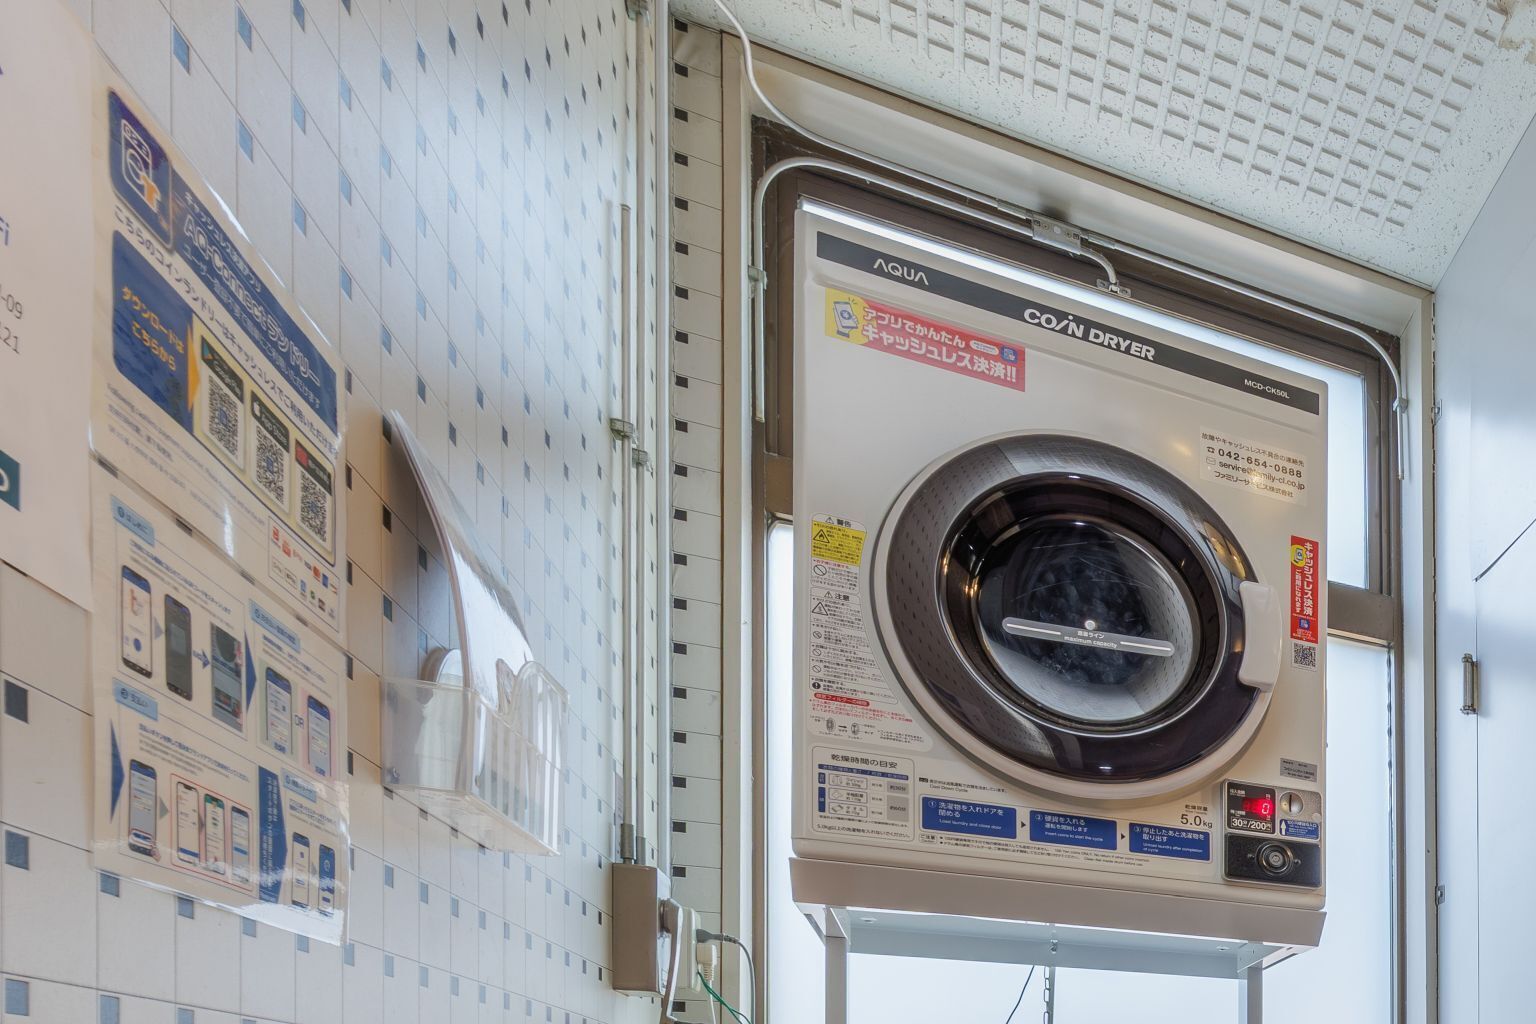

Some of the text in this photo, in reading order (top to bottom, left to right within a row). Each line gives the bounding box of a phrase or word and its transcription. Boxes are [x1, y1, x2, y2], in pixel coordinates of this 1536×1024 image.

[873, 258, 928, 286] AQUA
[864, 307, 966, 349] アプリでかんたん
[1088, 330, 1158, 361] DRYER
[1218, 448, 1302, 478] 042-654-0888
[1064, 636, 1118, 649] maximum capacity
[831, 754, 898, 769] 乾燥時間の目安
